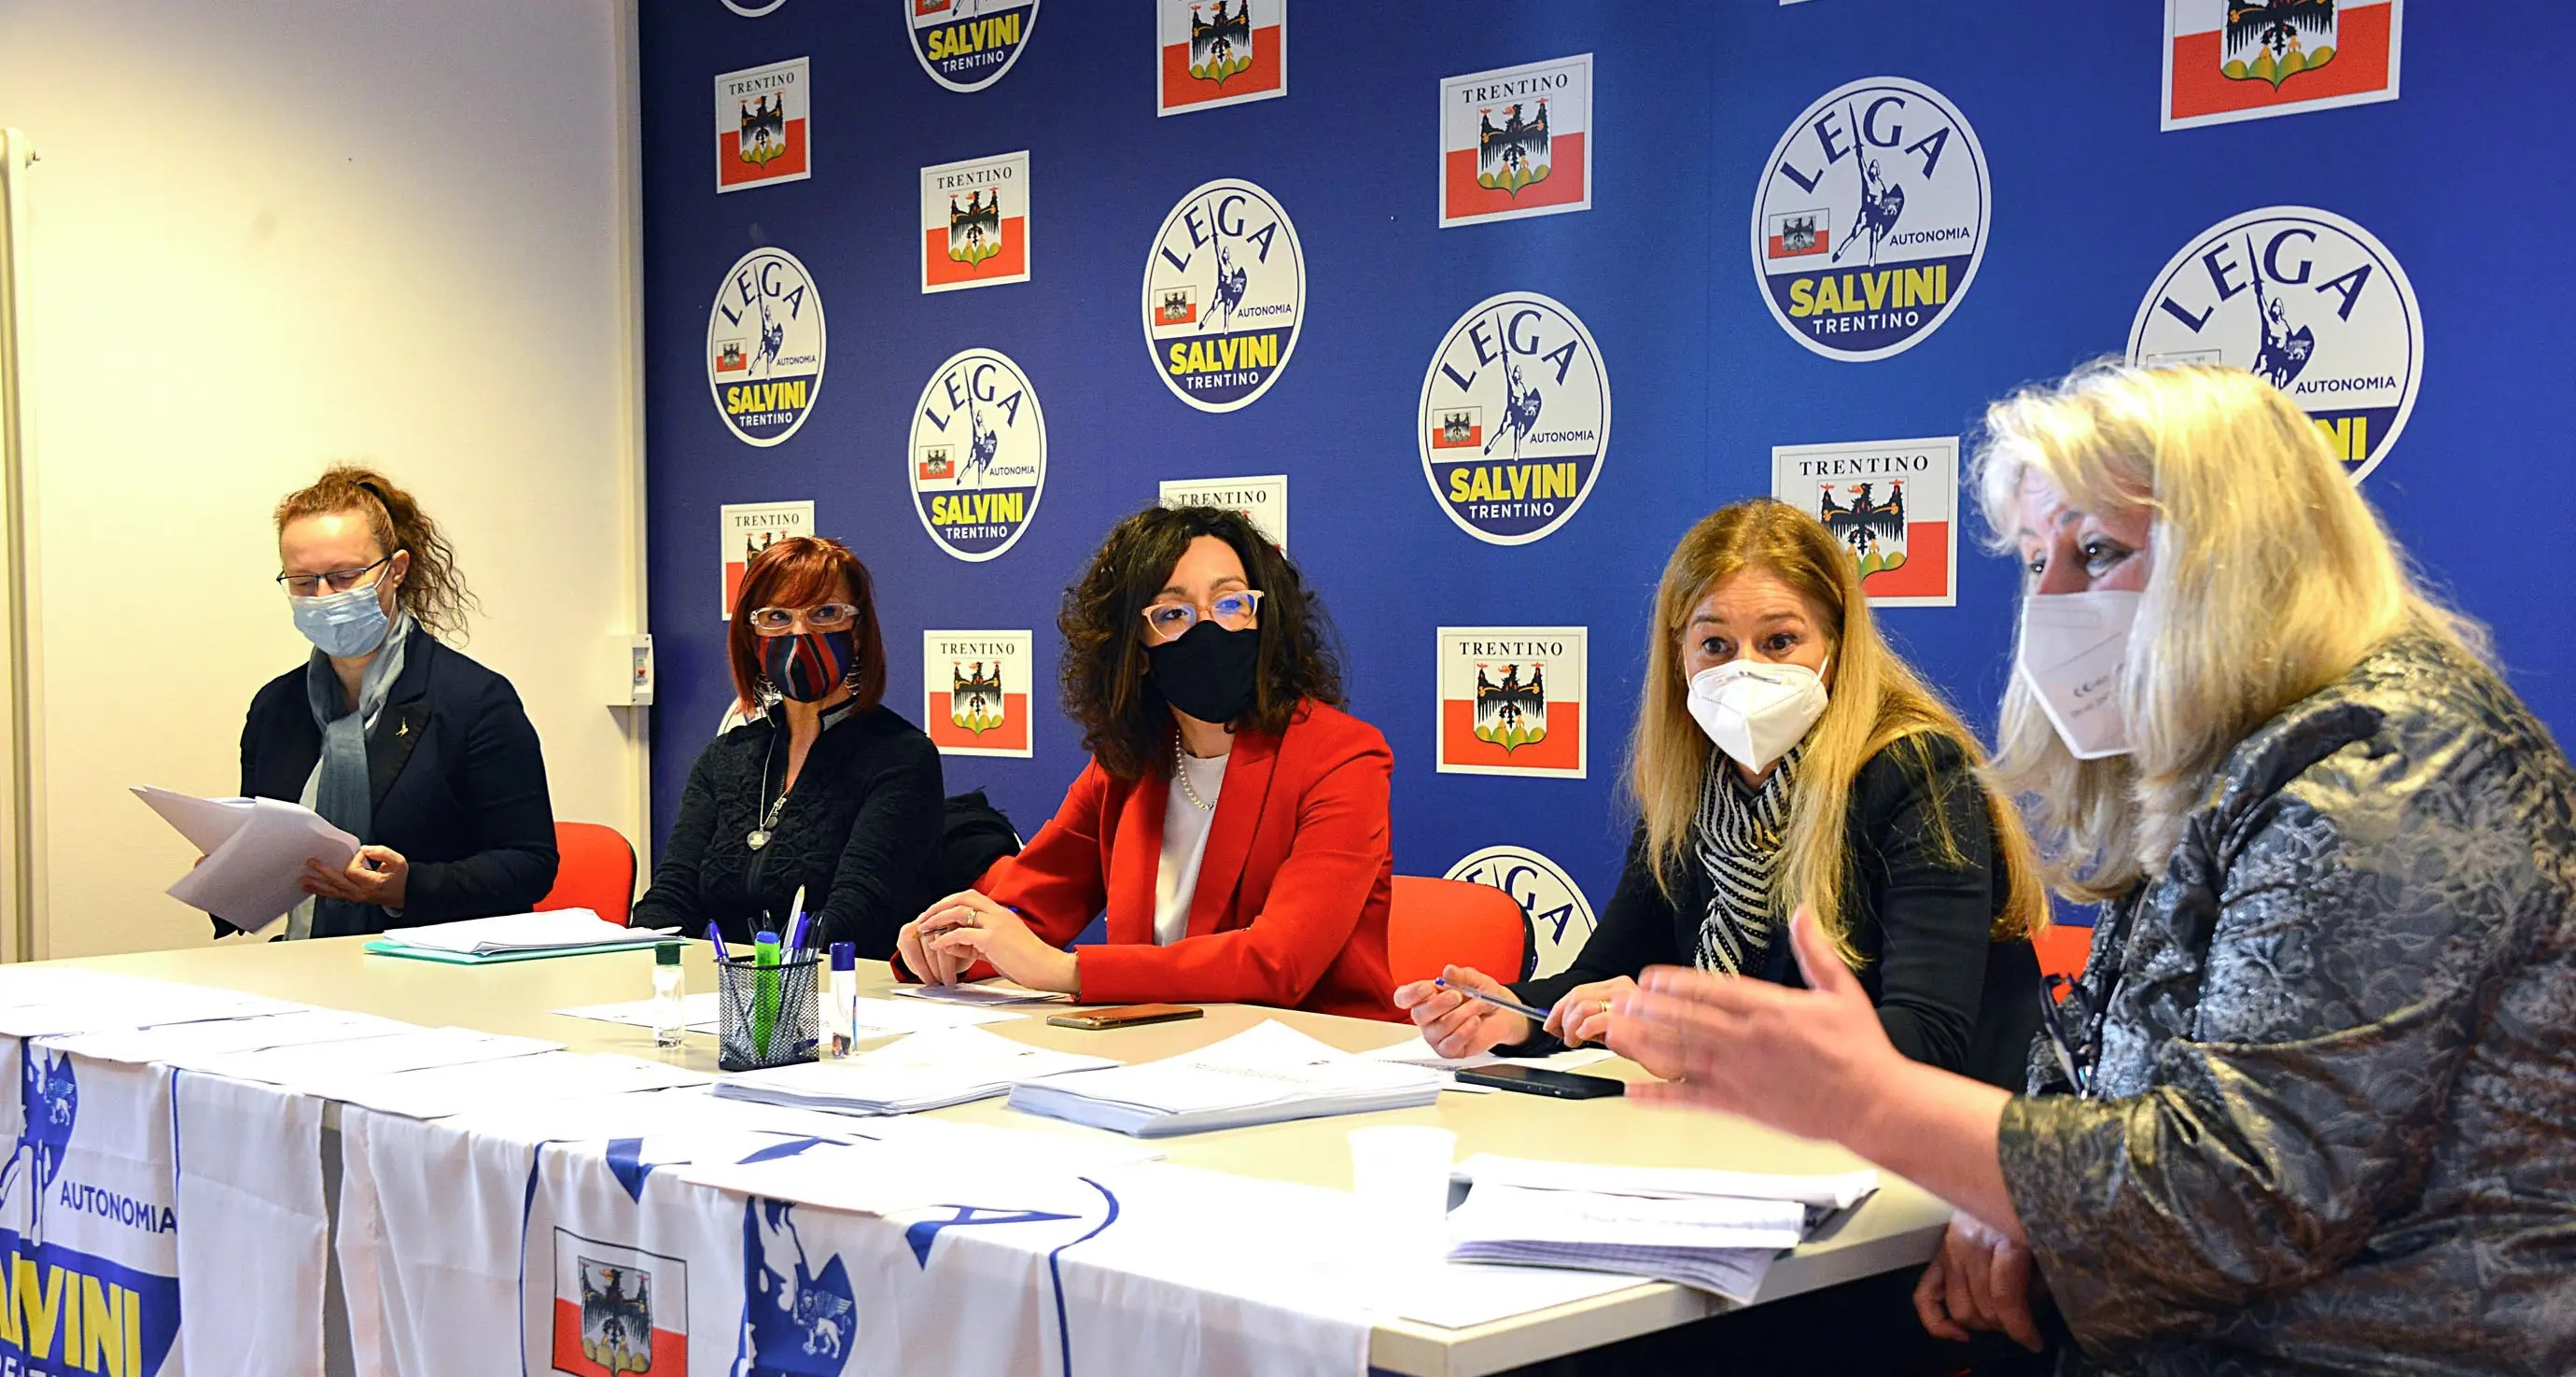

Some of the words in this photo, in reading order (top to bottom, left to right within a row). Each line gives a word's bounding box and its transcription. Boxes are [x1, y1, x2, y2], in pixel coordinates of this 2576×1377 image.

[928, 13, 1019, 61] SALVINI
[943, 50, 1004, 73] TRENTINO
[729, 72, 796, 95] TRENTINO
[1463, 73, 1569, 104] TRENTINO
[1780, 96, 1950, 194] LEGA
[937, 166, 1013, 190] TRENTINO
[1161, 195, 1277, 273] LEGA
[1890, 227, 1969, 246] AUTONOMIA
[1788, 264, 1947, 317] SALVINI
[2160, 229, 2373, 333] LEGA
[721, 261, 805, 327] LEGA
[1238, 303, 1292, 317] AUTONOMIA
[1813, 311, 1919, 334] TRENTINO
[777, 354, 817, 366] AUTONOMIA
[1169, 333, 1278, 374] SALVINI
[1441, 310, 1578, 392] LEGA
[1186, 372, 1259, 389] TRENTINO
[2295, 376, 2396, 394] AUTONOMIA
[726, 380, 806, 415] SALVINI
[925, 363, 1023, 432] LEGA
[739, 412, 792, 427] TRENTINO
[1530, 429, 1594, 443] AUTONOMIA
[989, 465, 1035, 476] AUTONOMIA
[1799, 455, 1928, 476] TRENTINO
[1449, 463, 1576, 502] SALVINI
[931, 492, 1023, 526] SALVINI
[1179, 490, 1267, 505] TRENTINO
[735, 513, 800, 527] TRENTINO
[1469, 502, 1554, 518] TRENTINO
[945, 526, 1008, 539] TRENTINO
[941, 641, 1015, 655] TRENTINO
[1460, 641, 1563, 655] TRENTINO
[1465, 865, 1574, 946] GA
[60, 1180, 177, 1234] AUTONOMIA
